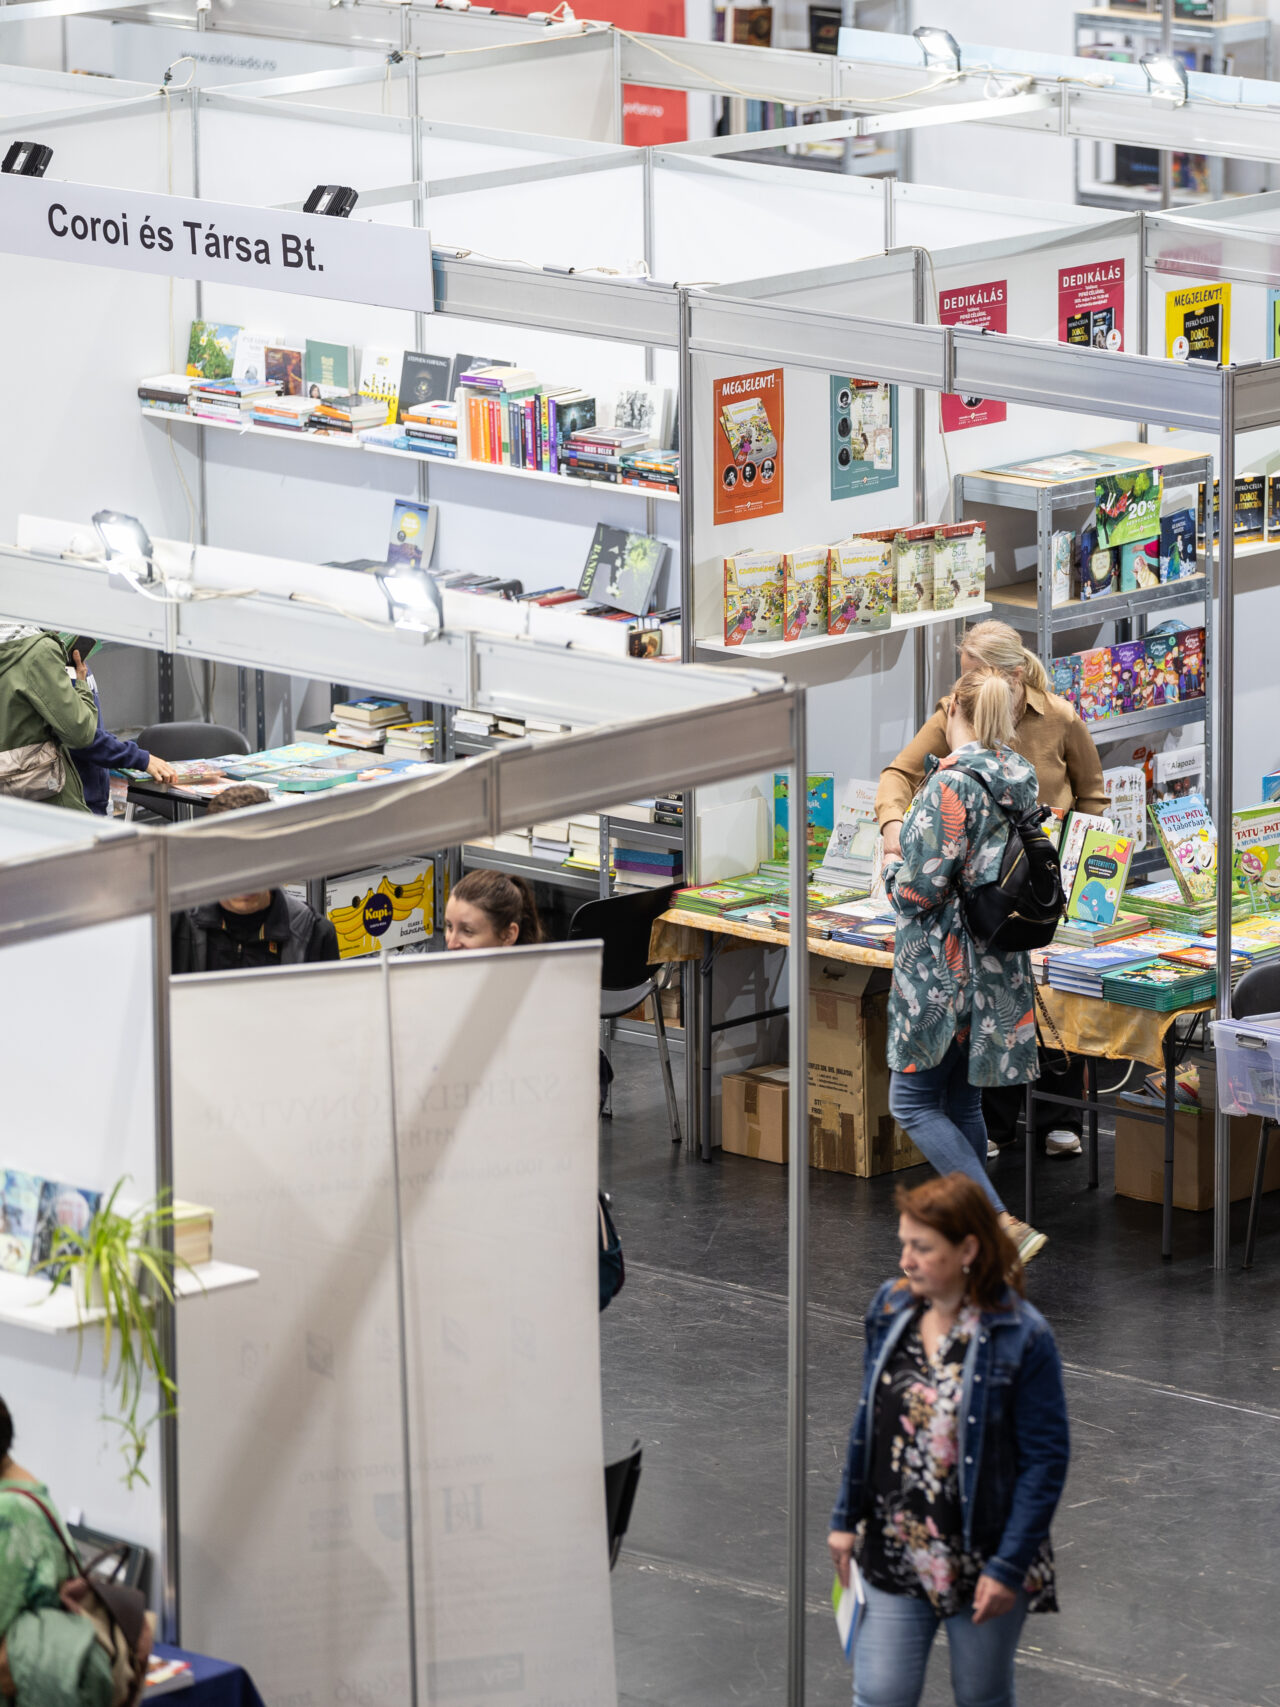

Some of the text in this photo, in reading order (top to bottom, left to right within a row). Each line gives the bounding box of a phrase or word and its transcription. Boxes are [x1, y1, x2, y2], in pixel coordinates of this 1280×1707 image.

[48, 203, 324, 272] Coroi és Társa Bt.
[1063, 265, 1121, 288] DEDIKÁLÁS
[943, 287, 1004, 310] DEDIKÁLÁS
[1174, 287, 1223, 307] MEGJELENT!
[722, 373, 775, 396] MEGJELENT!
[1128, 500, 1156, 520] 20%
[581, 544, 602, 592] BANKSY
[1171, 757, 1196, 770] Alapozó
[1161, 814, 1181, 825] TATU
[1185, 809, 1204, 820] PATU
[1235, 827, 1259, 841] TATU
[364, 904, 389, 921] Kapi
